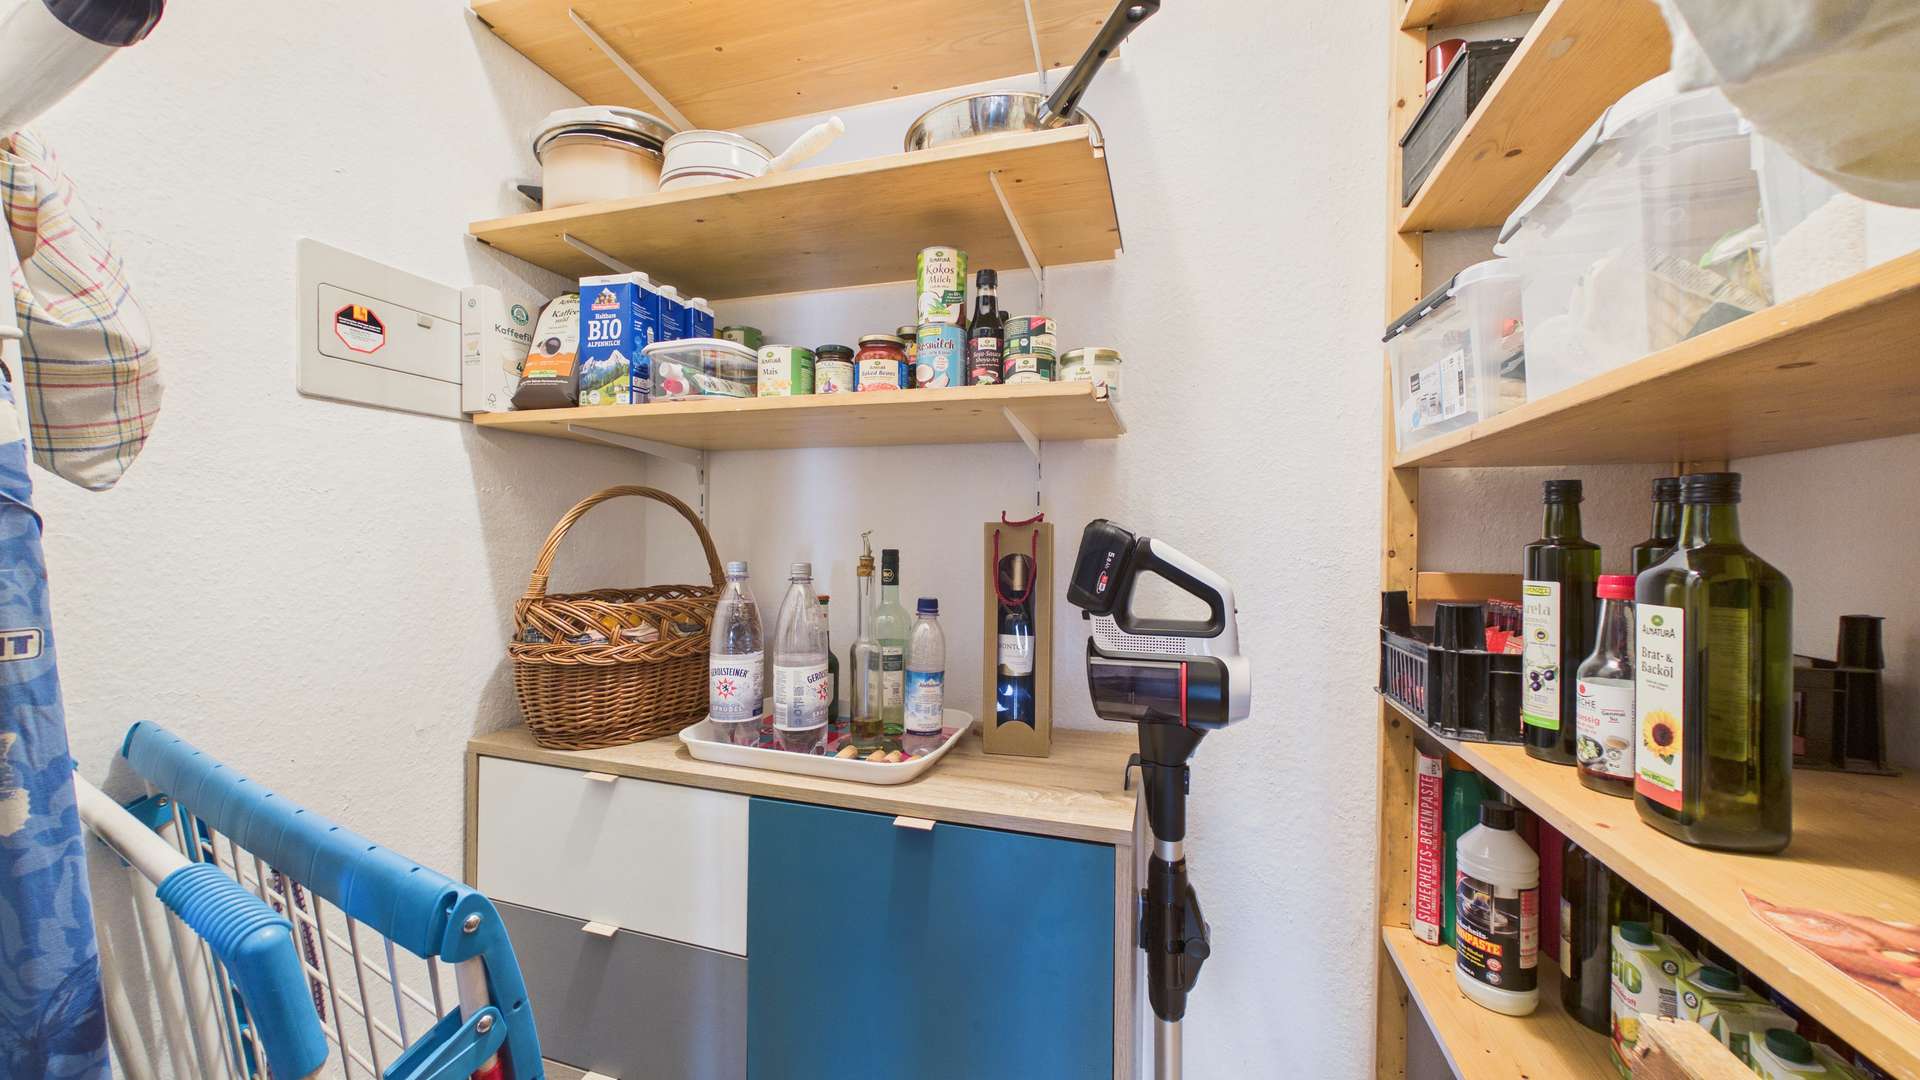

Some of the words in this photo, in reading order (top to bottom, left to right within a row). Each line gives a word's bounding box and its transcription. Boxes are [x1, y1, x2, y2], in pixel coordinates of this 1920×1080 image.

[926, 263, 955, 275] Kokos
[928, 275, 951, 284] Milch
[587, 318, 622, 341] BIO
[763, 368, 779, 376] Mais
[1641, 646, 1664, 661] Brat-
[1666, 653, 1673, 663] &
[1641, 661, 1674, 679] Backöl
[1417, 775, 1434, 922] SICHERHEITS-BRENNPASTE
